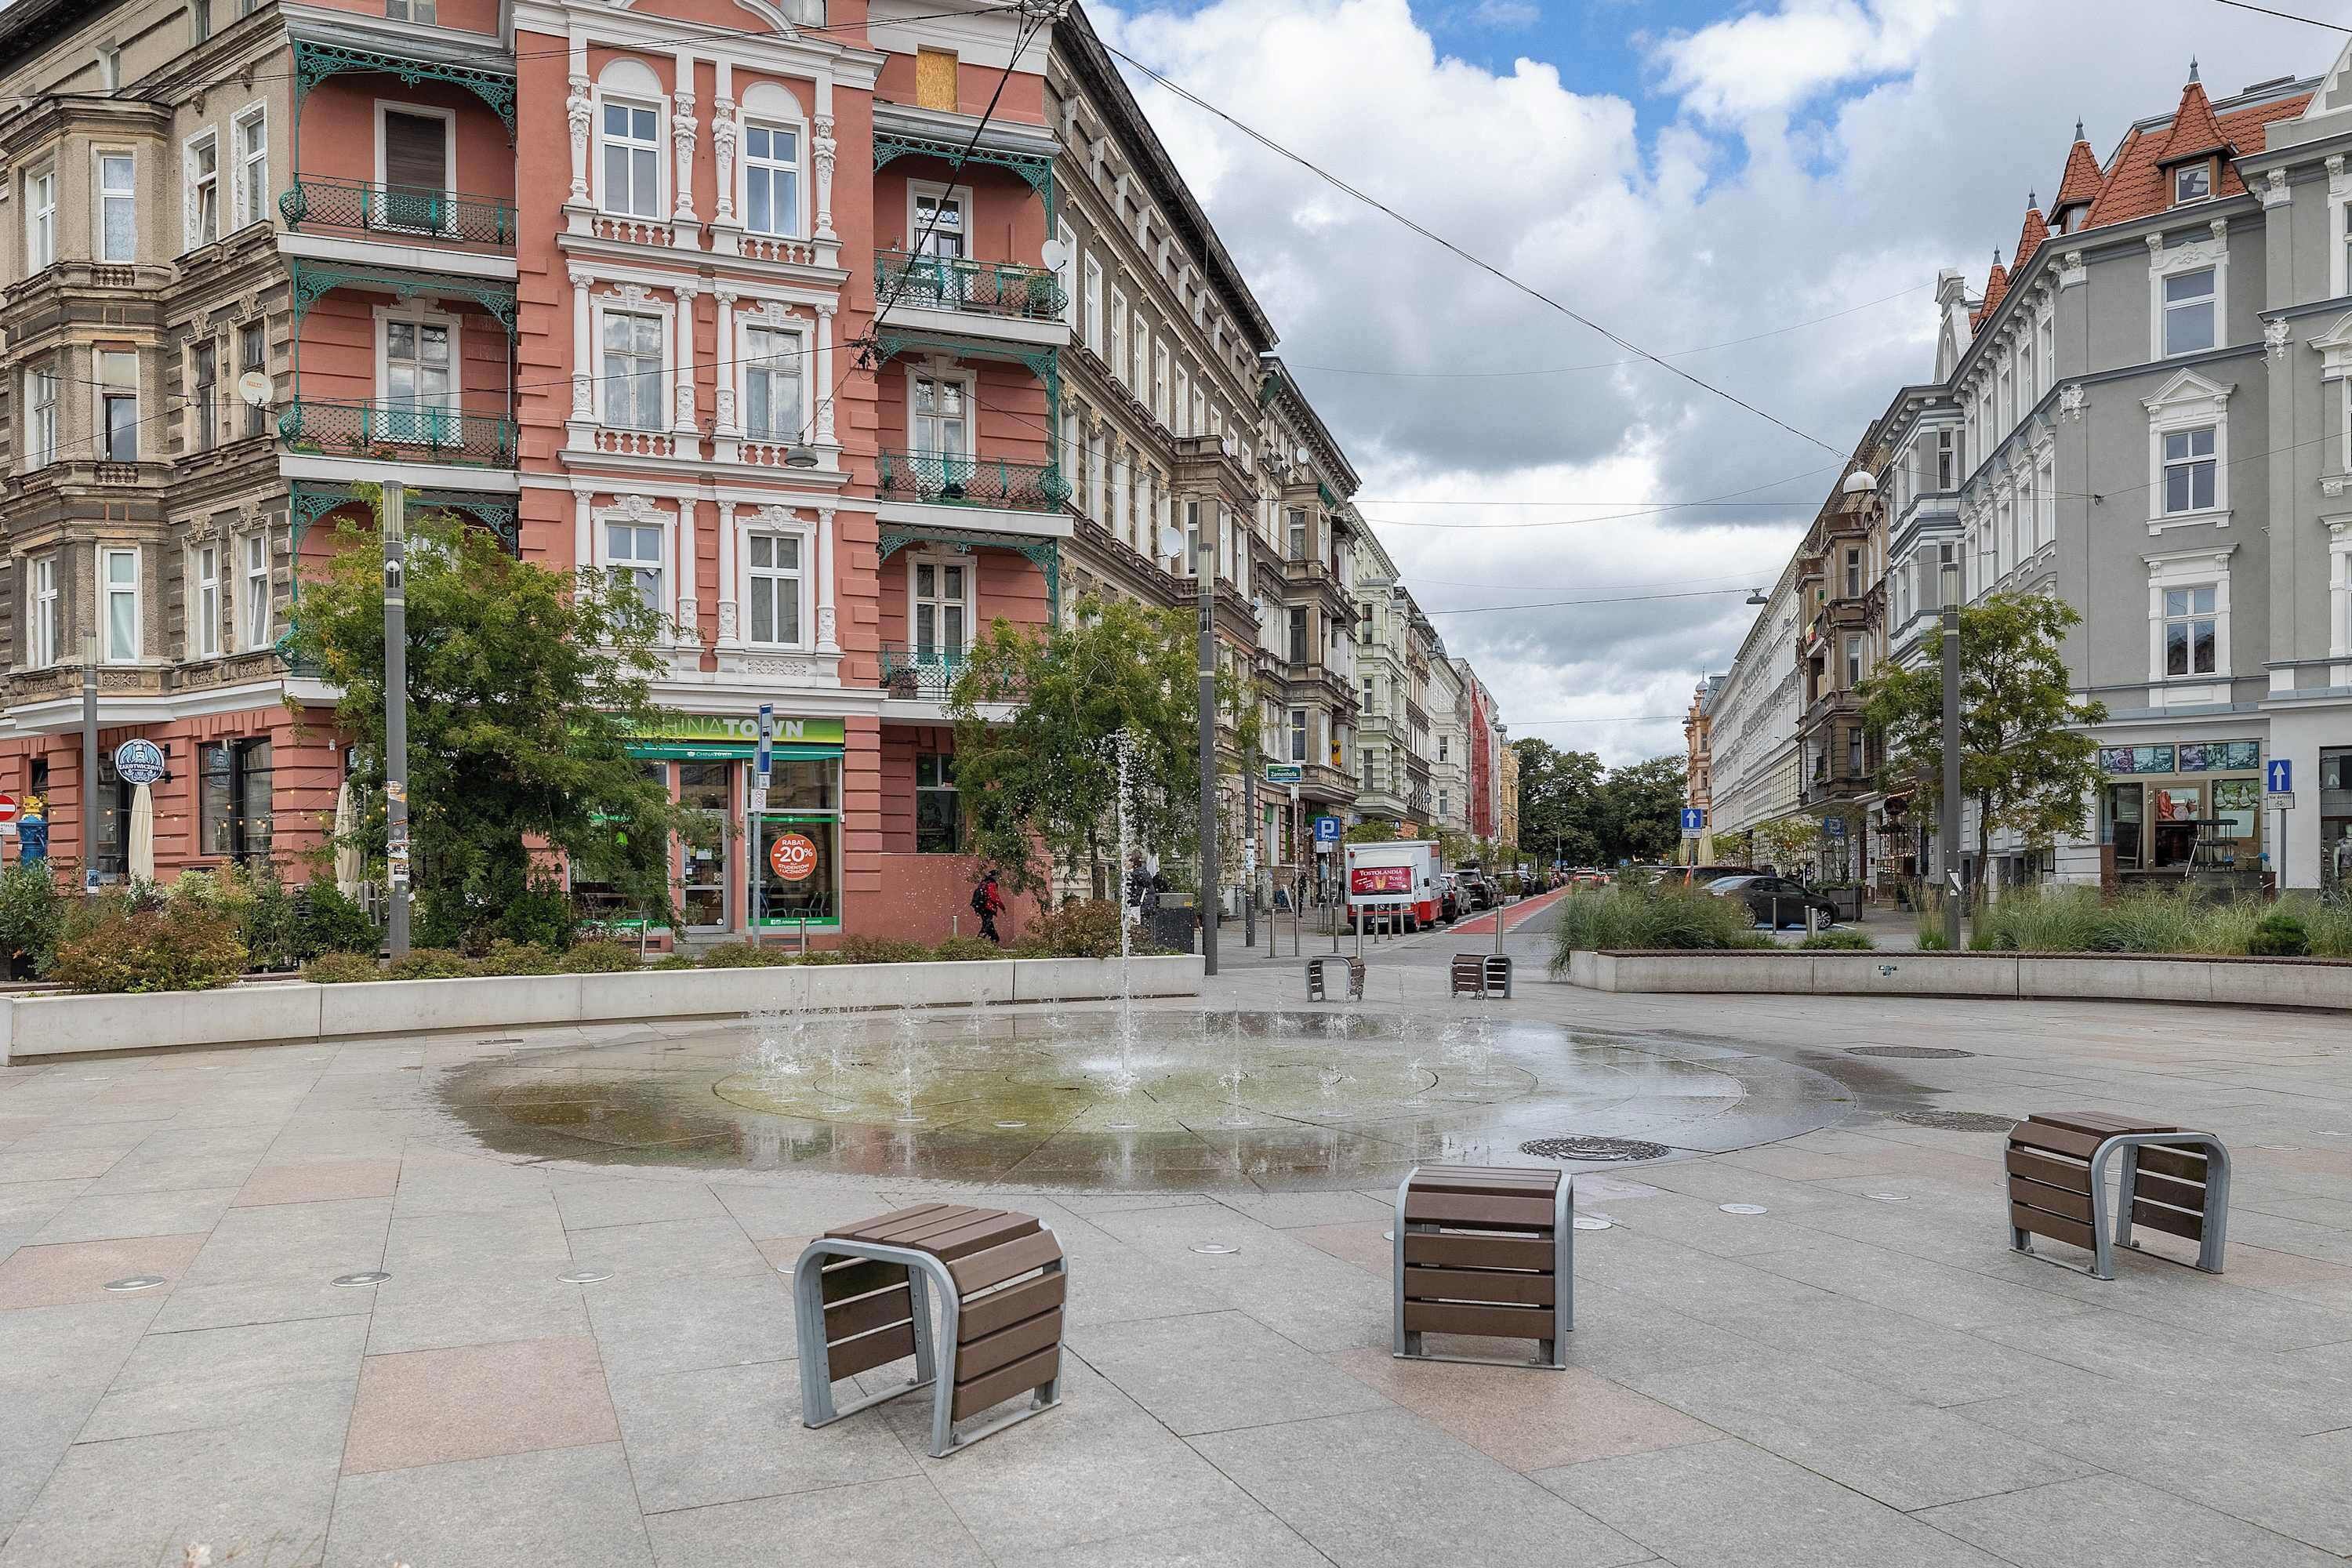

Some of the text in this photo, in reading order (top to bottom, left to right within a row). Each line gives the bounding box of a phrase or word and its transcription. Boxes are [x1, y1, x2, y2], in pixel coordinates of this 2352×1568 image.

[662, 717, 804, 738] HINATOWN
[1321, 820, 1334, 839] P
[774, 846, 813, 862] -20%
